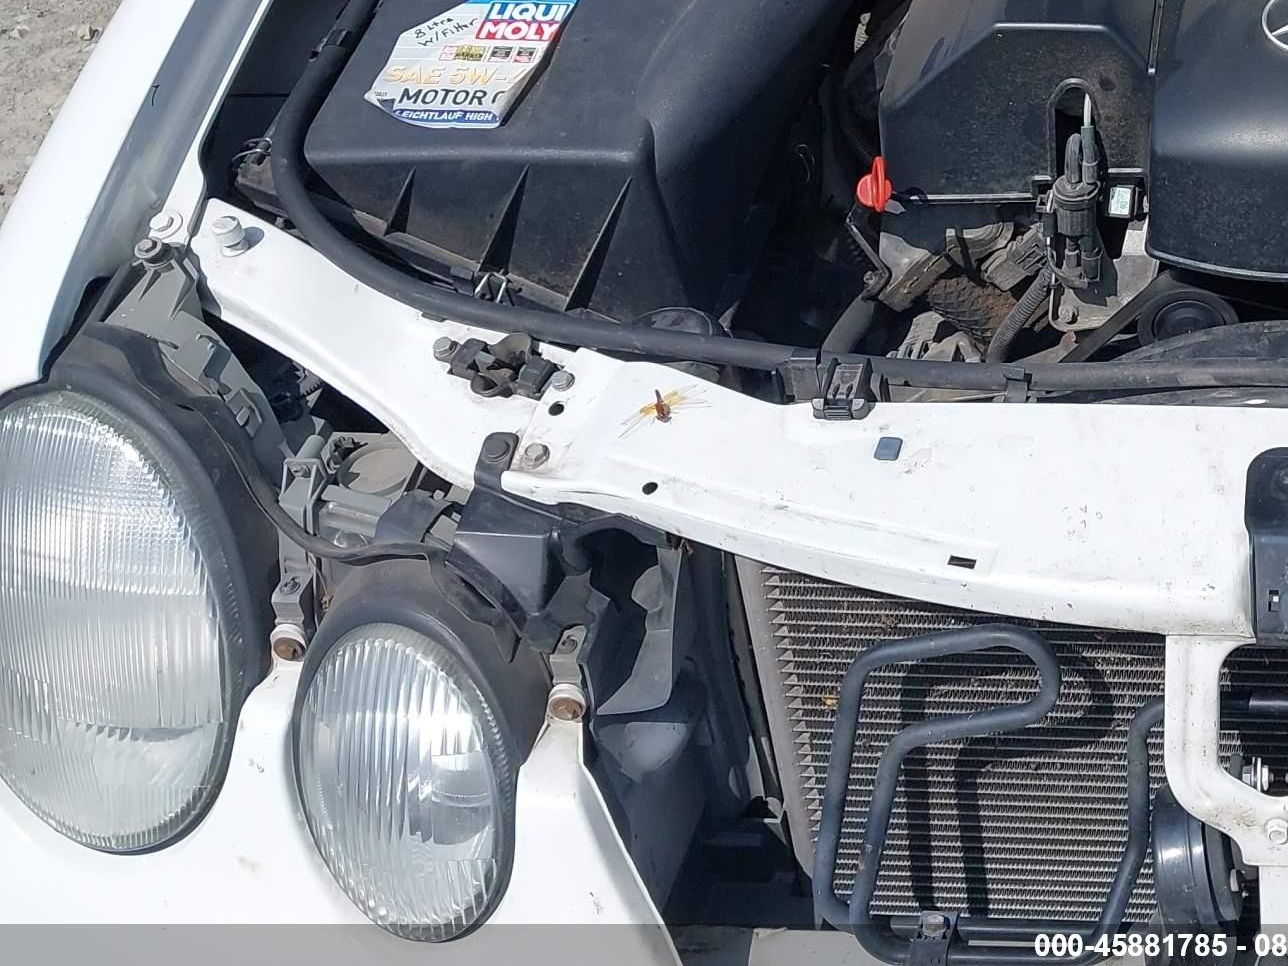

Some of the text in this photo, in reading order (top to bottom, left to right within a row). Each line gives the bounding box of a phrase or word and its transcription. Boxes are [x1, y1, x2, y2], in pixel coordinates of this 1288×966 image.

[488, 3, 568, 21] LIQUI
[414, 28, 427, 39] 8
[480, 21, 561, 40] MOLY
[383, 66, 446, 85] SAE
[398, 88, 487, 106] MOTOR
[465, 113, 494, 121] HIGH
